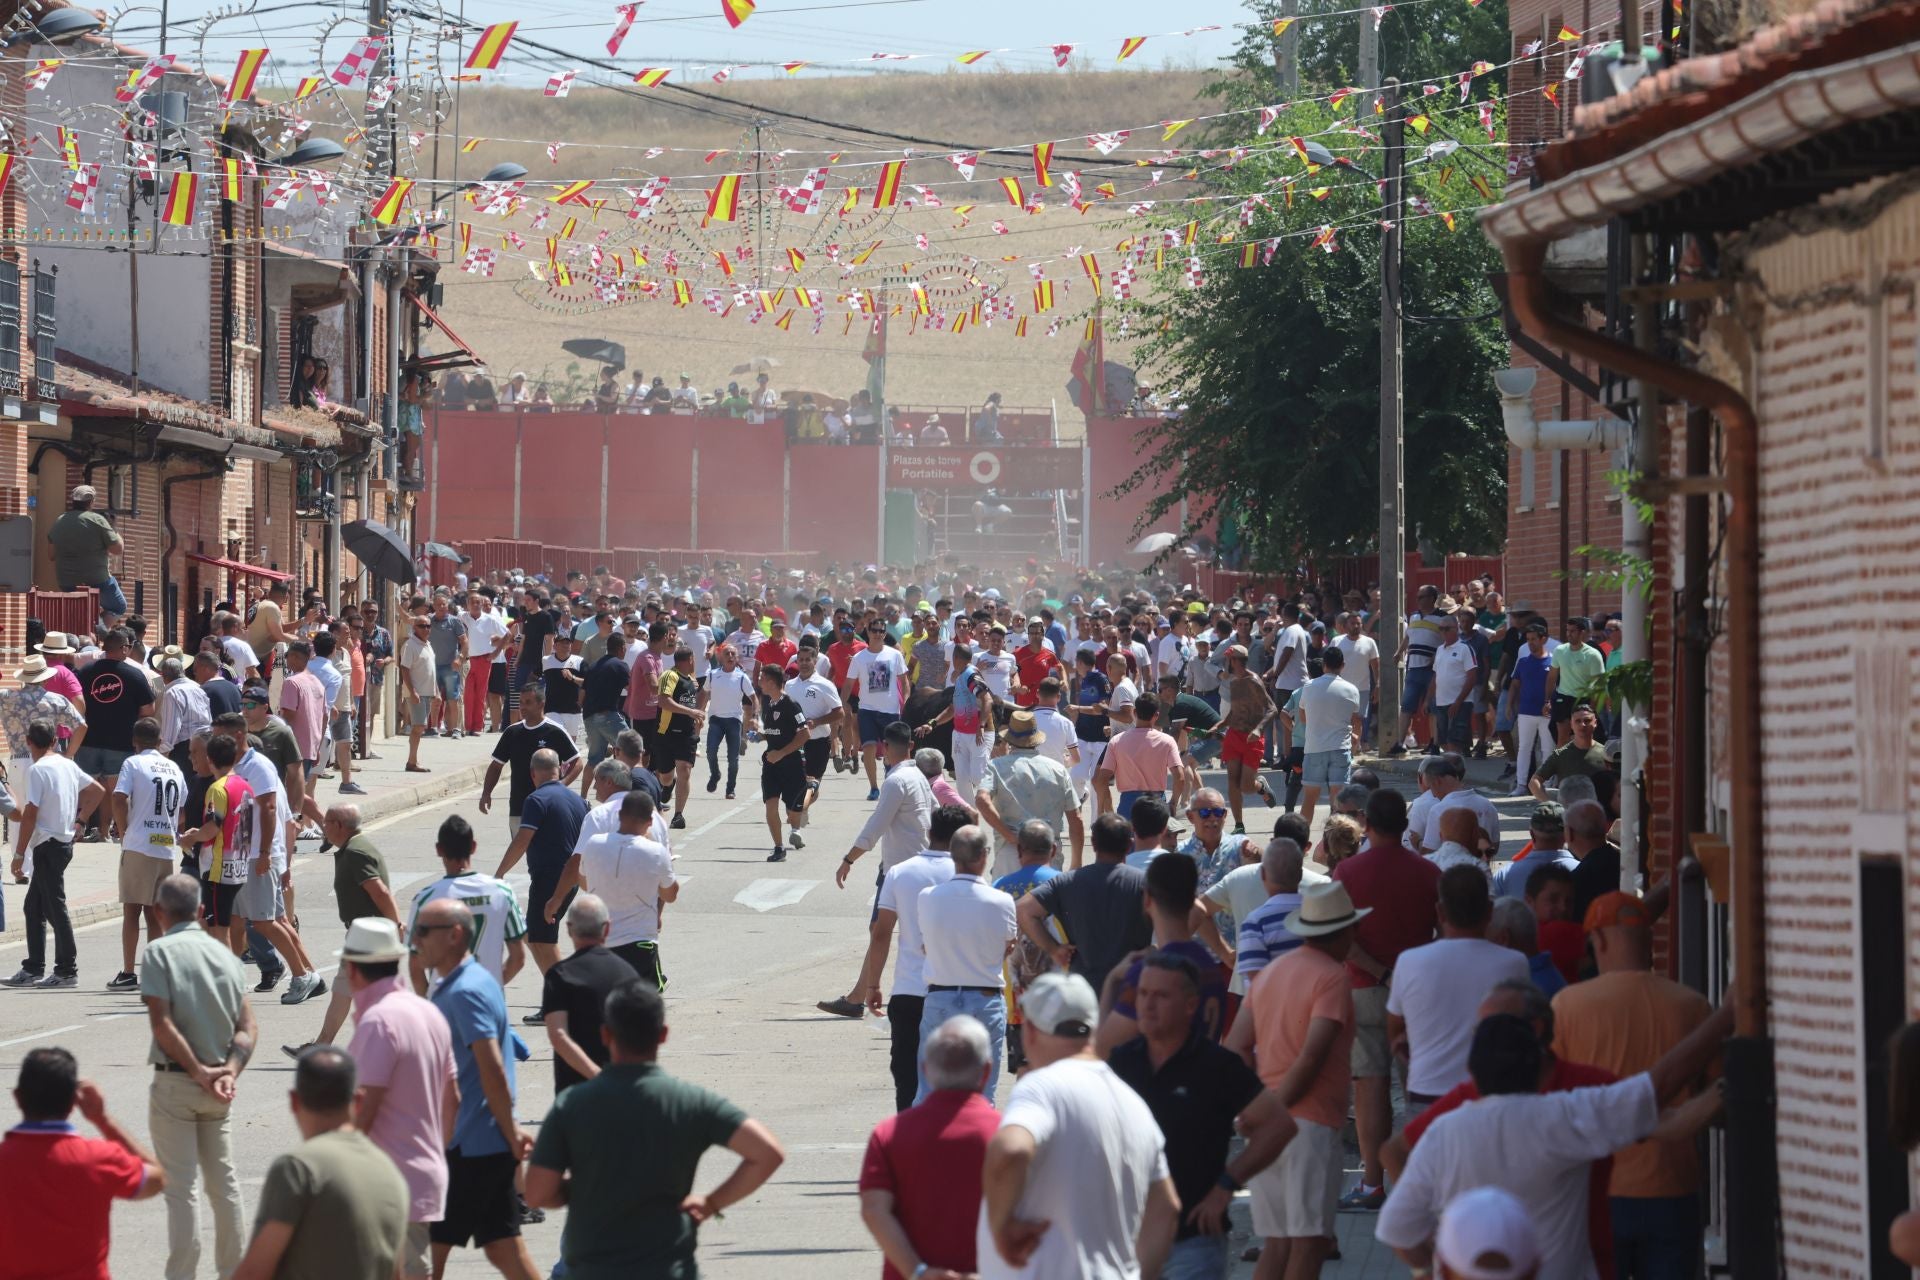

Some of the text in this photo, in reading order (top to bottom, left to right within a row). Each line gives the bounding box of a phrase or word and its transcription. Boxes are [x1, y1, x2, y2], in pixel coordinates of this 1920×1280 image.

[893, 455, 922, 465] Plazas
[924, 455, 936, 465] de
[902, 468, 954, 479] Portatiles
[152, 777, 179, 817] 10
